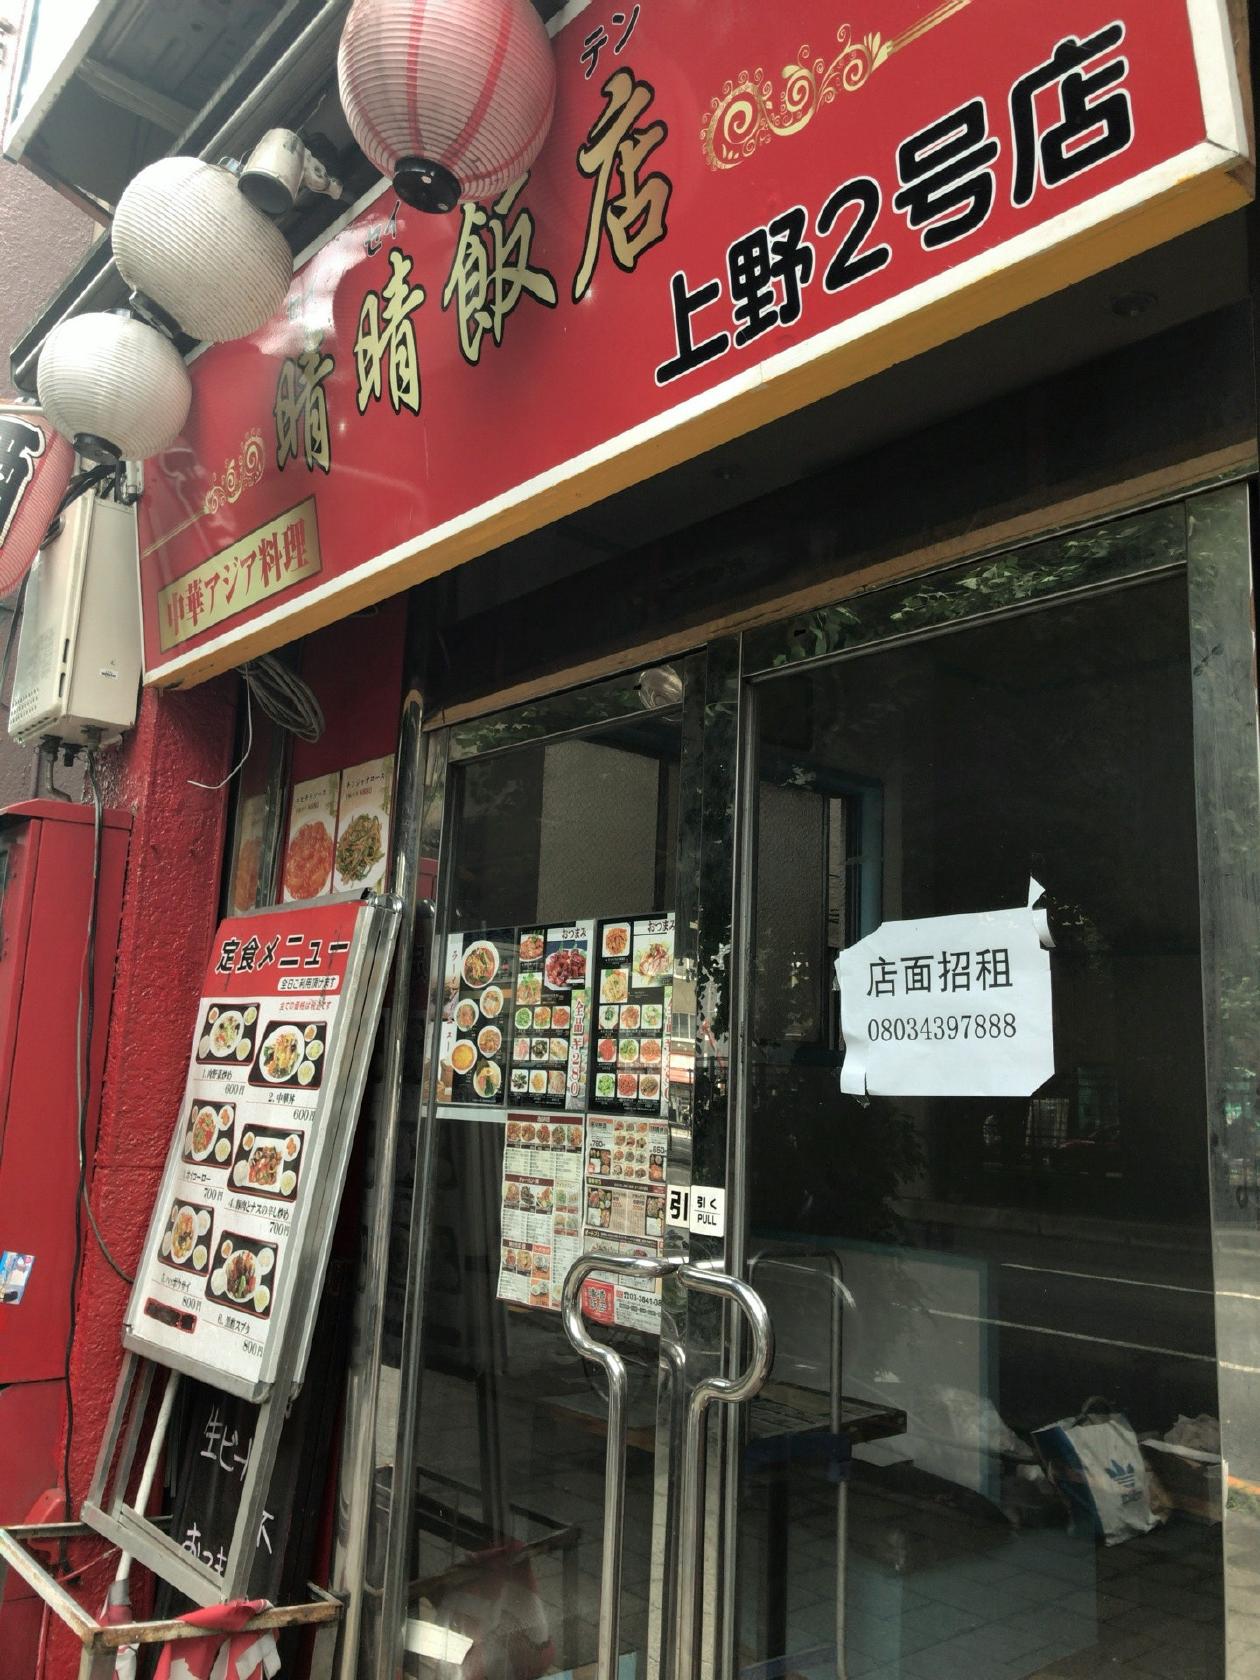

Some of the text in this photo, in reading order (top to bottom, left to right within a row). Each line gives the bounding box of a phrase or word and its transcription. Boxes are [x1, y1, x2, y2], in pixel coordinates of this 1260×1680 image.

[580, 4, 641, 80] テン
[655, 20, 1133, 386] 上野2号店
[167, 518, 310, 637] 中華アジア料理
[561, 927, 587, 940] おつまみ
[215, 934, 350, 974] 定食メニュー
[866, 948, 1013, 998] 店面招租
[867, 1013, 1017, 1041] 08034397888
[670, 1190, 689, 1222] 引
[697, 1196, 717, 1210] 引く
[697, 1214, 717, 1226] PULL
